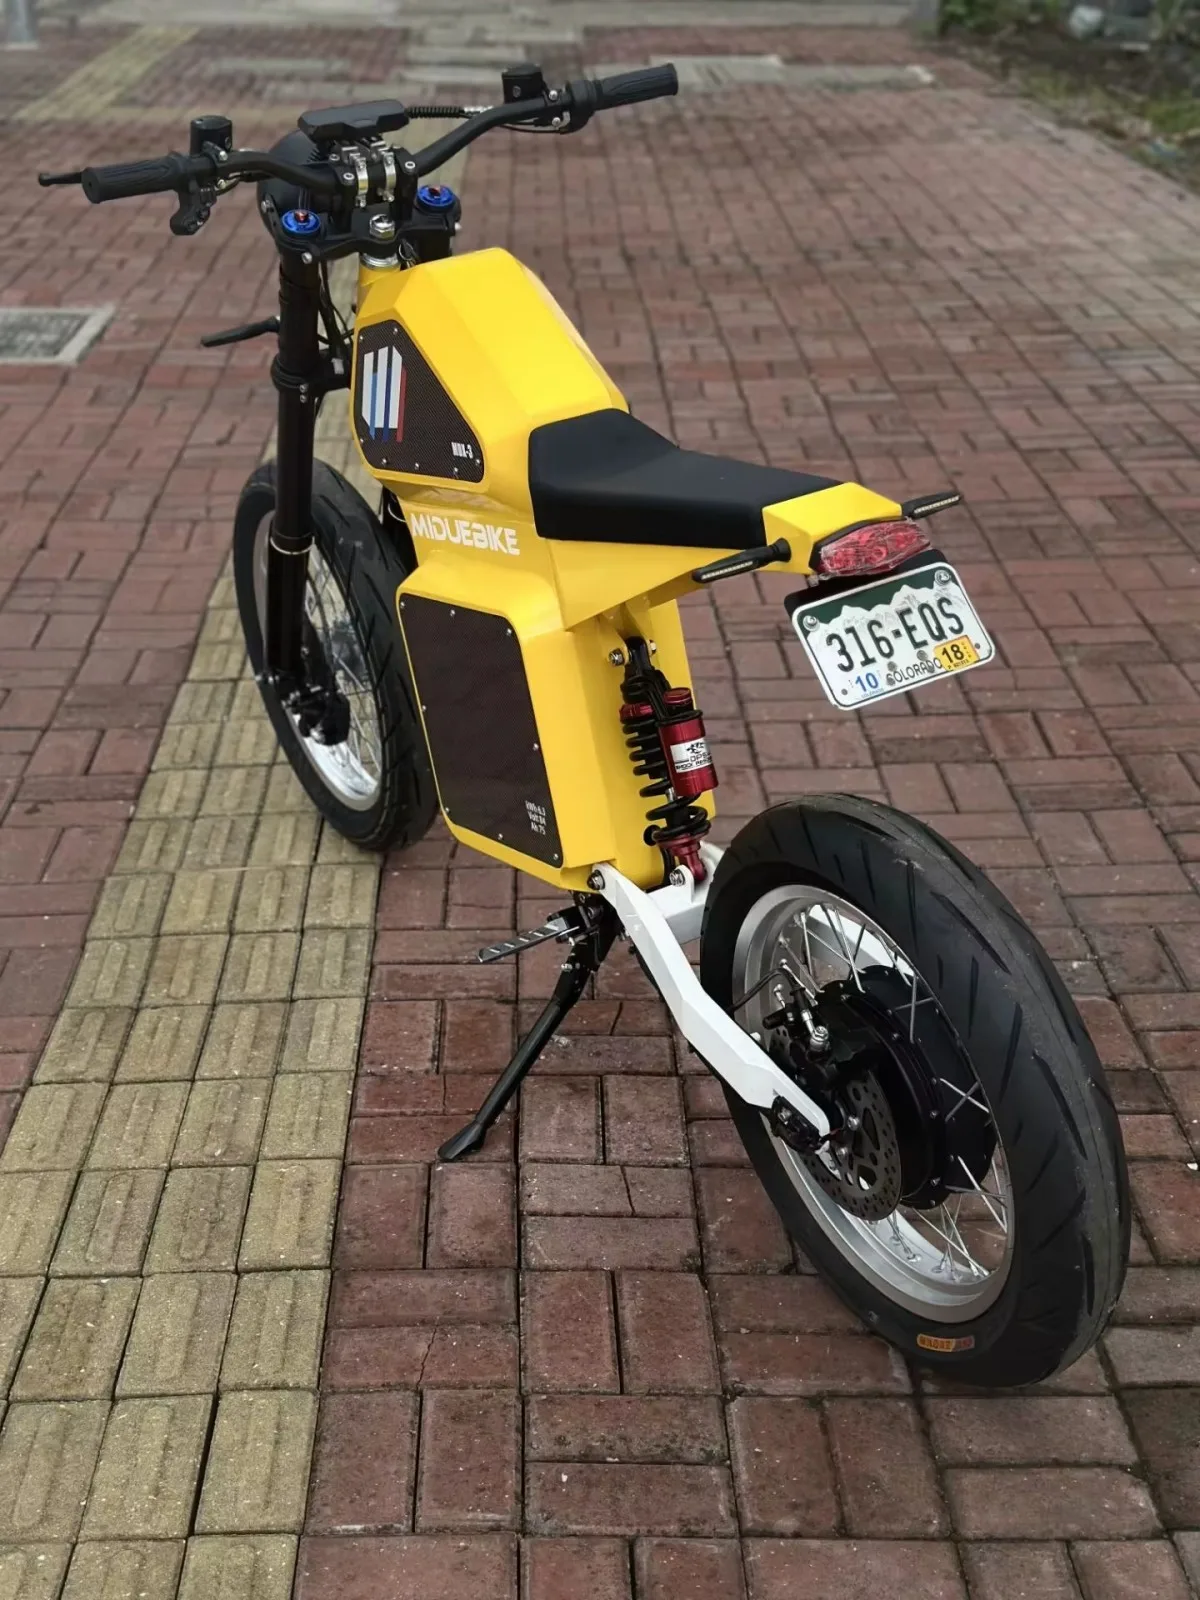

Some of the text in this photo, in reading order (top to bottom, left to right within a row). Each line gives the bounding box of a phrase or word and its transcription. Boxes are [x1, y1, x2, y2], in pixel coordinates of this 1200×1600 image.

[411, 513, 520, 555] MIDUEBIKE
[826, 597, 964, 672] 316-EQS
[941, 643, 964, 663] 18
[855, 673, 879, 692] 10
